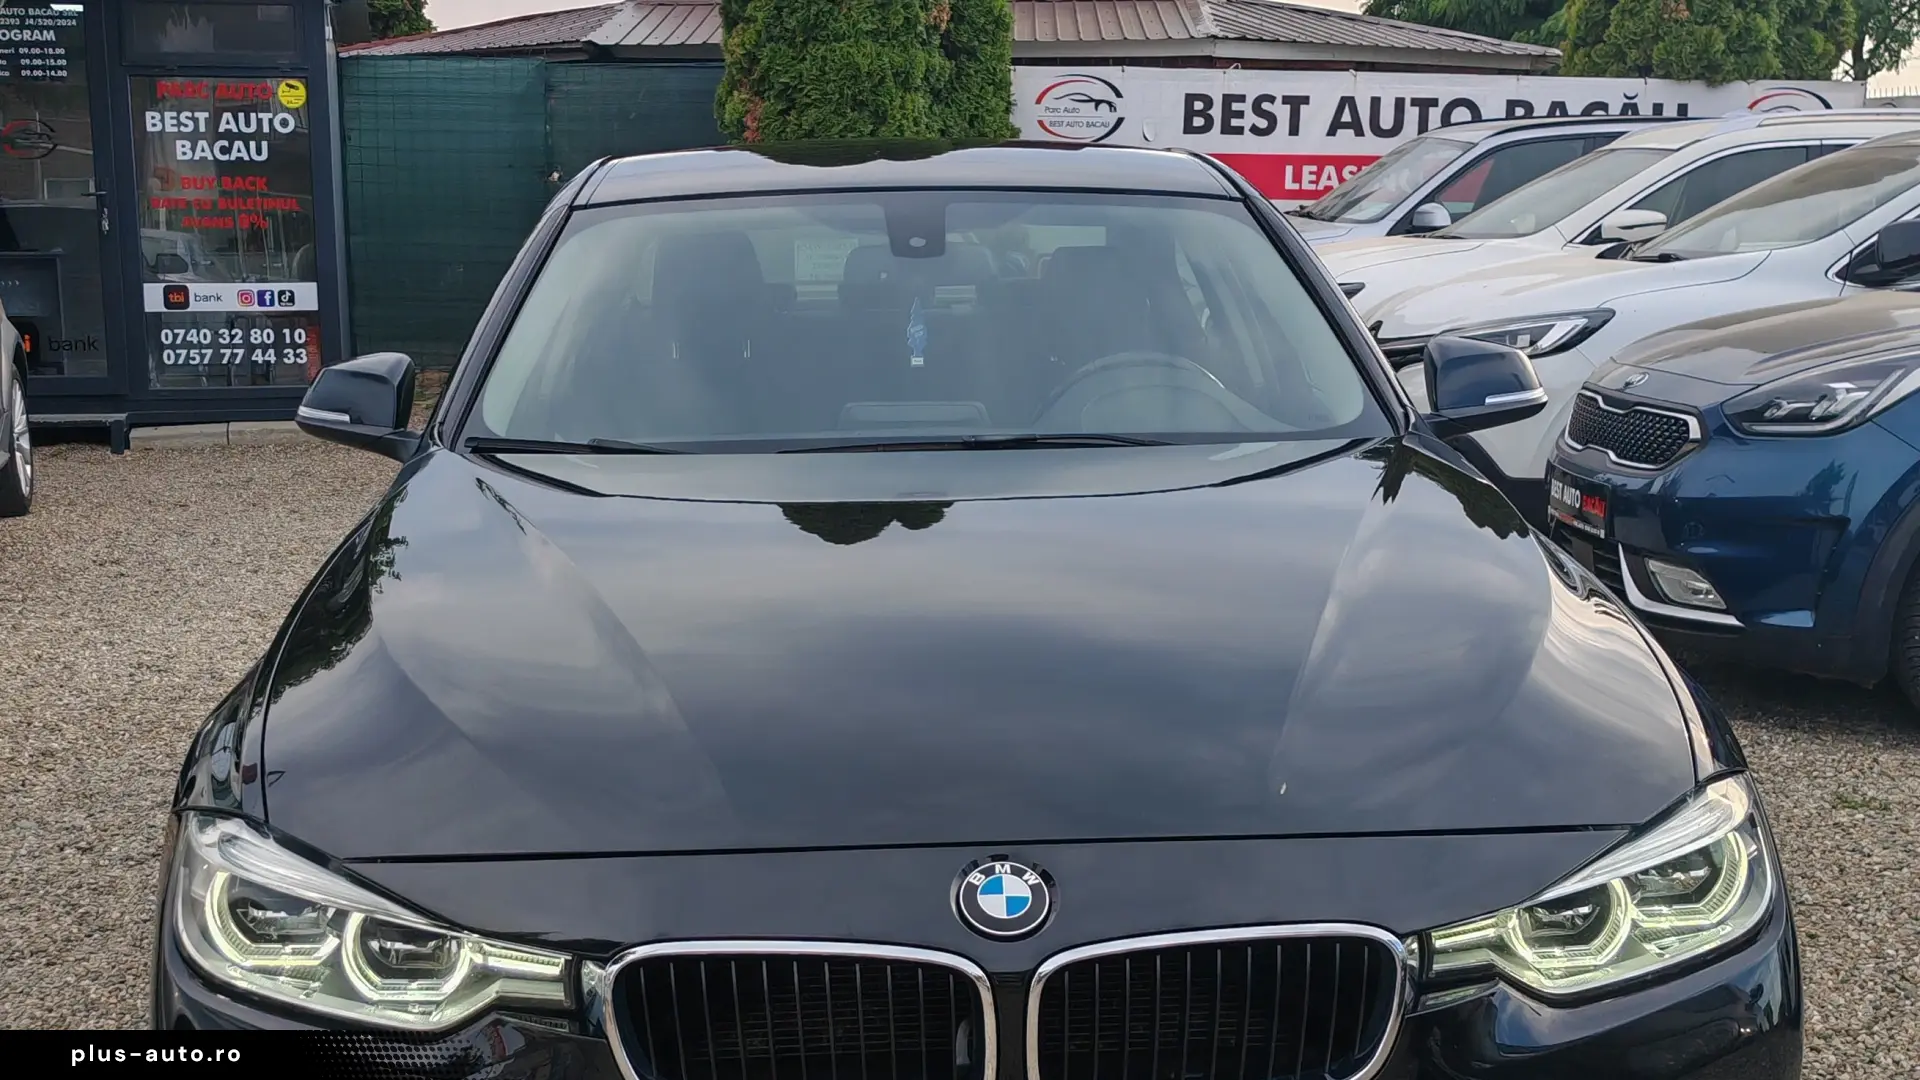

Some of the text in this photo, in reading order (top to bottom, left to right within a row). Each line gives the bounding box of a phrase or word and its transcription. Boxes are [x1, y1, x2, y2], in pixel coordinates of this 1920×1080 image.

[0, 7, 25, 16] AUTO
[28, 8, 60, 16] BACAU
[156, 80, 210, 99] PARC
[215, 81, 273, 100] AUTO
[1044, 106, 1080, 114] Parc Auto
[1183, 92, 1310, 137] BEST
[1326, 96, 1483, 138] AUTO
[145, 111, 296, 134] BEST AUTO
[1049, 120, 1064, 128] BEST
[1065, 120, 1084, 128] AUTO
[175, 139, 269, 162] BACAU
[181, 175, 269, 191] BUY BACK
[1284, 164, 1371, 191] LEAS
[218, 197, 302, 212] BULETINUL
[168, 291, 223, 303] tbi bank
[48, 335, 99, 352] bank
[160, 328, 307, 344] 0740 32 80 10
[162, 348, 308, 365] 0757 77 44 33
[1551, 478, 1563, 501] BEST
[1562, 484, 1581, 509] AUTO
[968, 863, 1041, 886] BMW
